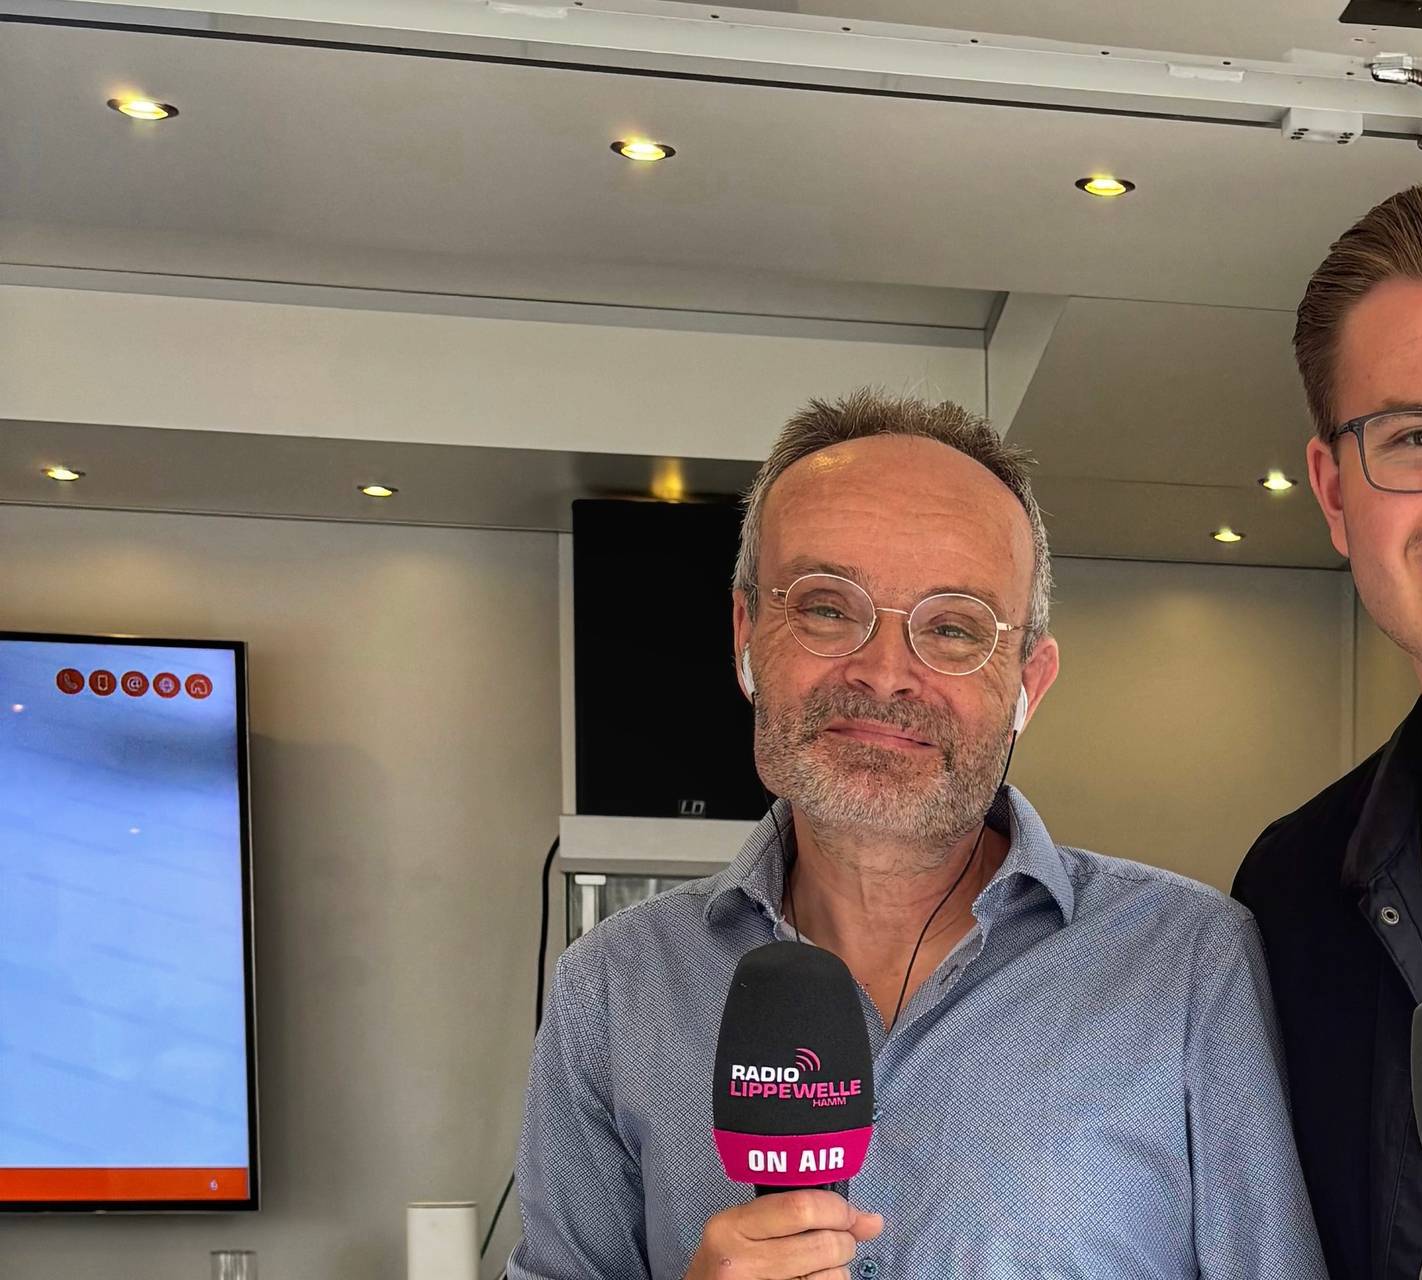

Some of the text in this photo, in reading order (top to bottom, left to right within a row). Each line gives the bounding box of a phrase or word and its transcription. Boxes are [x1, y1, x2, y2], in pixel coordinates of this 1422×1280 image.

[731, 1064, 800, 1083] RADIO
[729, 1079, 862, 1099] LIPPEWELLE
[812, 1097, 847, 1107] HAMM
[748, 1147, 845, 1173] ON AIR
